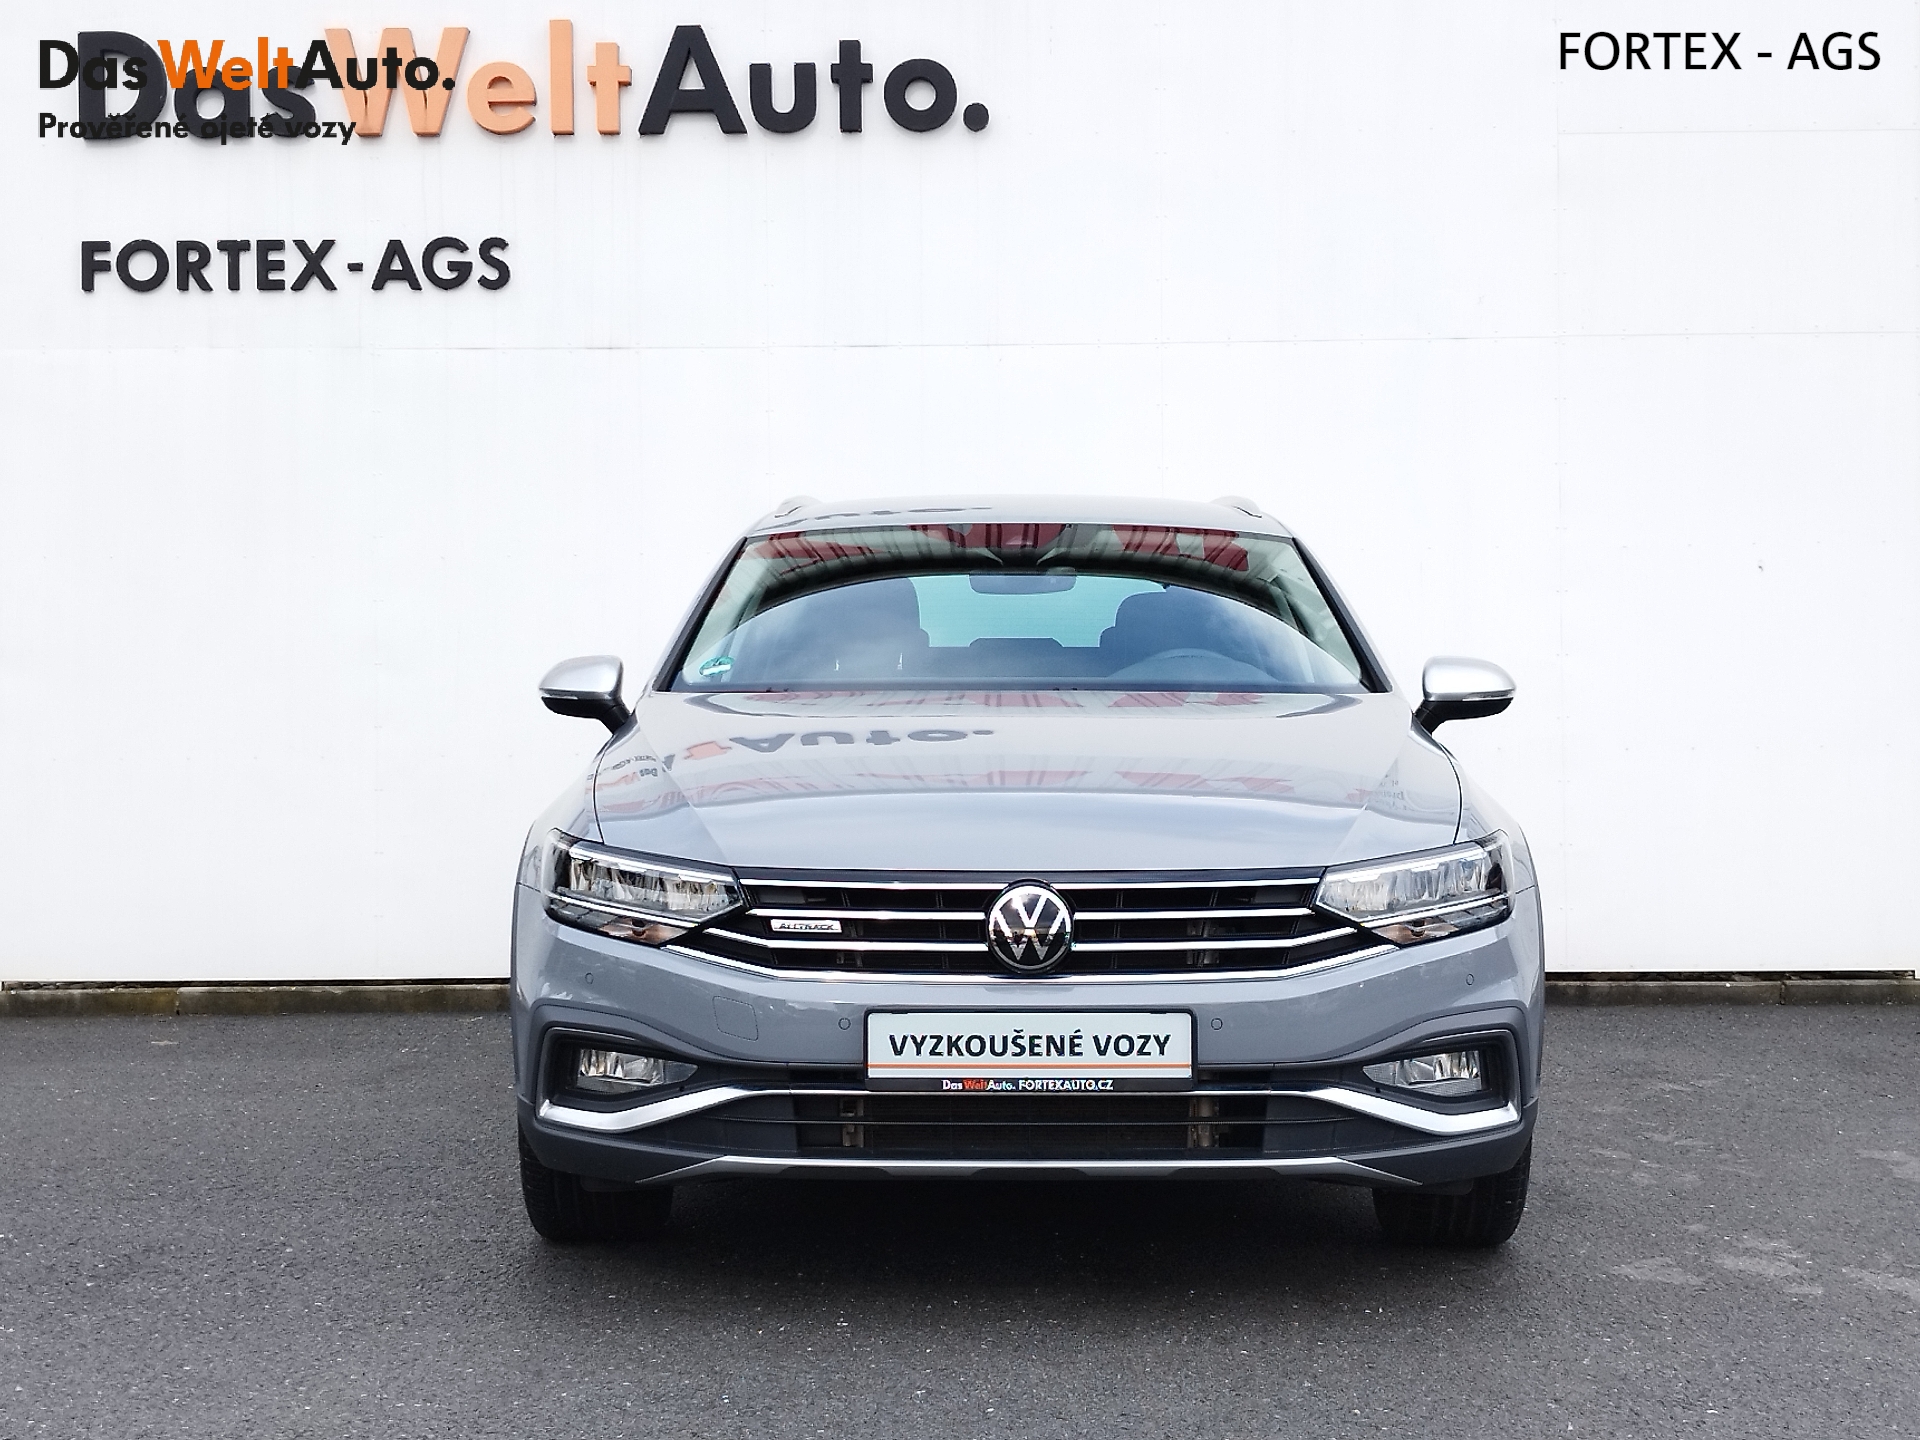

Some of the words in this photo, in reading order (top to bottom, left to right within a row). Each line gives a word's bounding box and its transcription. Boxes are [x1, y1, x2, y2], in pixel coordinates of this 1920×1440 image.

[779, 922, 835, 932] ALLTRACK
[889, 1028, 1084, 1057] VYZKOUŠENÉ
[1092, 1034, 1172, 1057] VOZY
[1018, 1079, 1114, 1092] FORTEXAUTO.CZ
